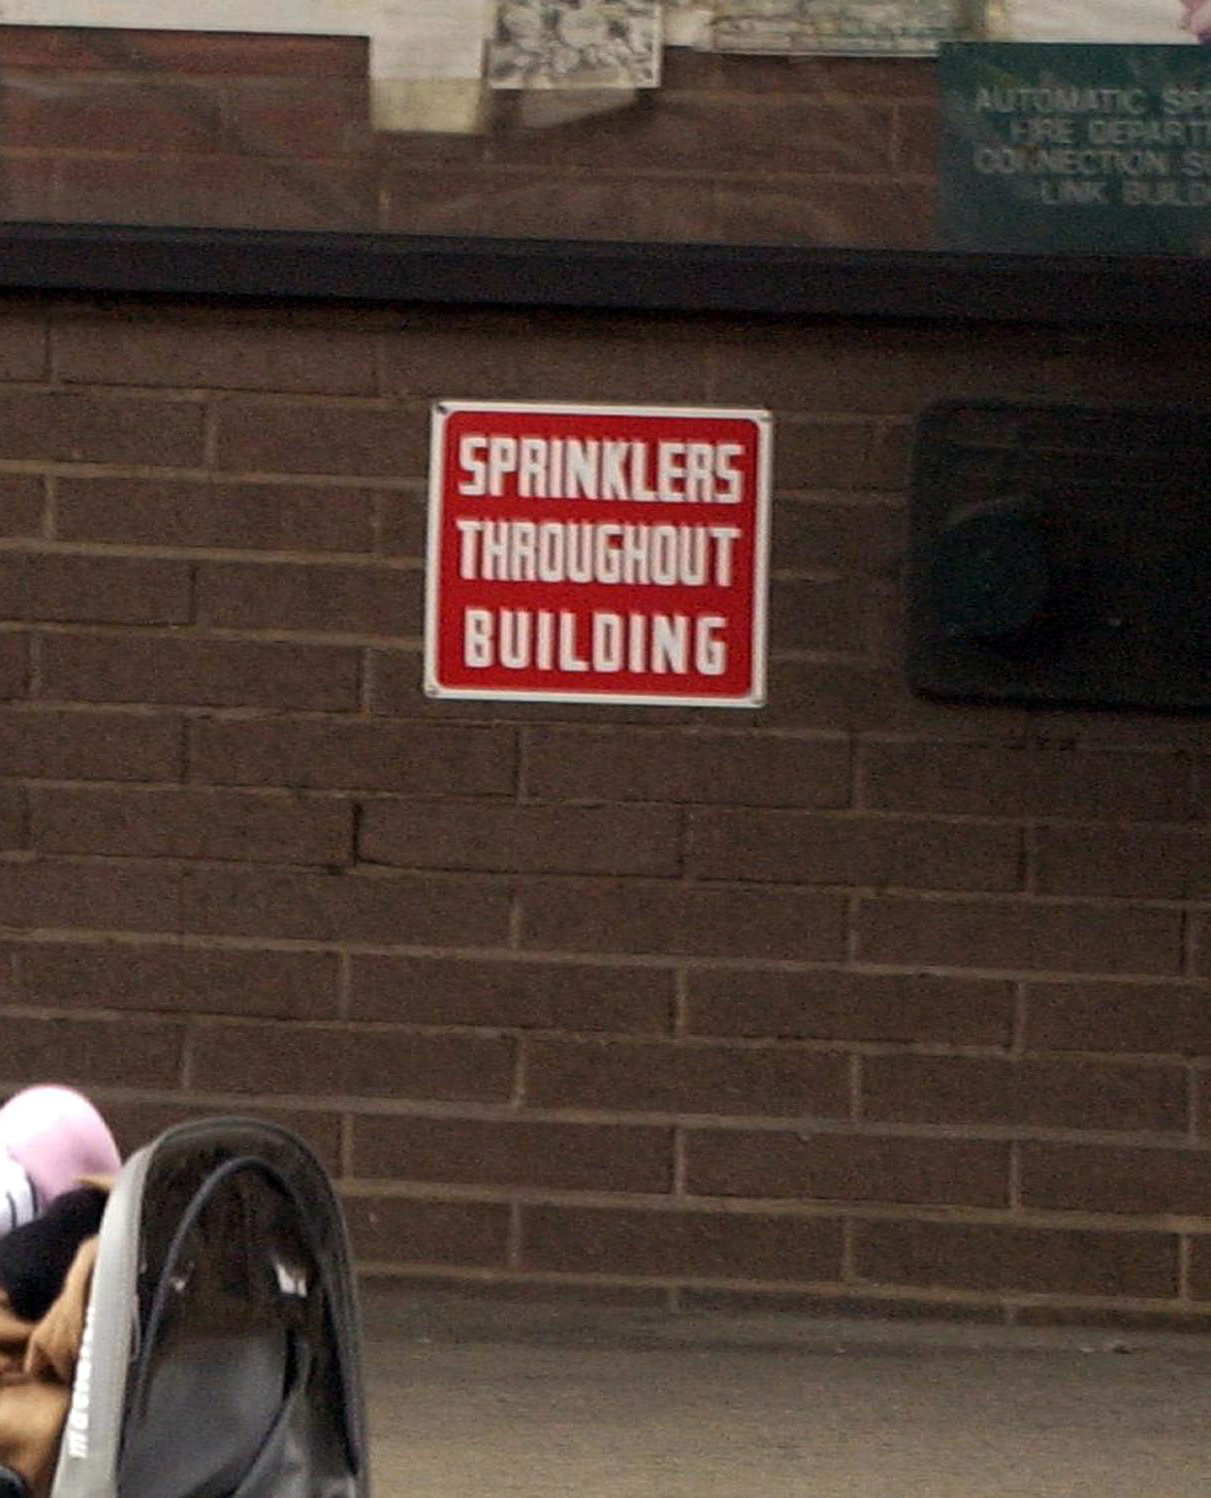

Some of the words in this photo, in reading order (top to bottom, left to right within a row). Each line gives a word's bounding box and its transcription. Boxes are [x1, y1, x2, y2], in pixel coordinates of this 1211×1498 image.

[976, 87, 1145, 115] AUTOMATIC
[1010, 119, 1075, 145] FIRE
[973, 148, 1169, 176] CONNECTION
[1041, 181, 1108, 205] LINK
[457, 435, 744, 504] SPRINKLERS
[456, 518, 741, 587] THROUGHOUT
[464, 606, 728, 676] BUILDING
